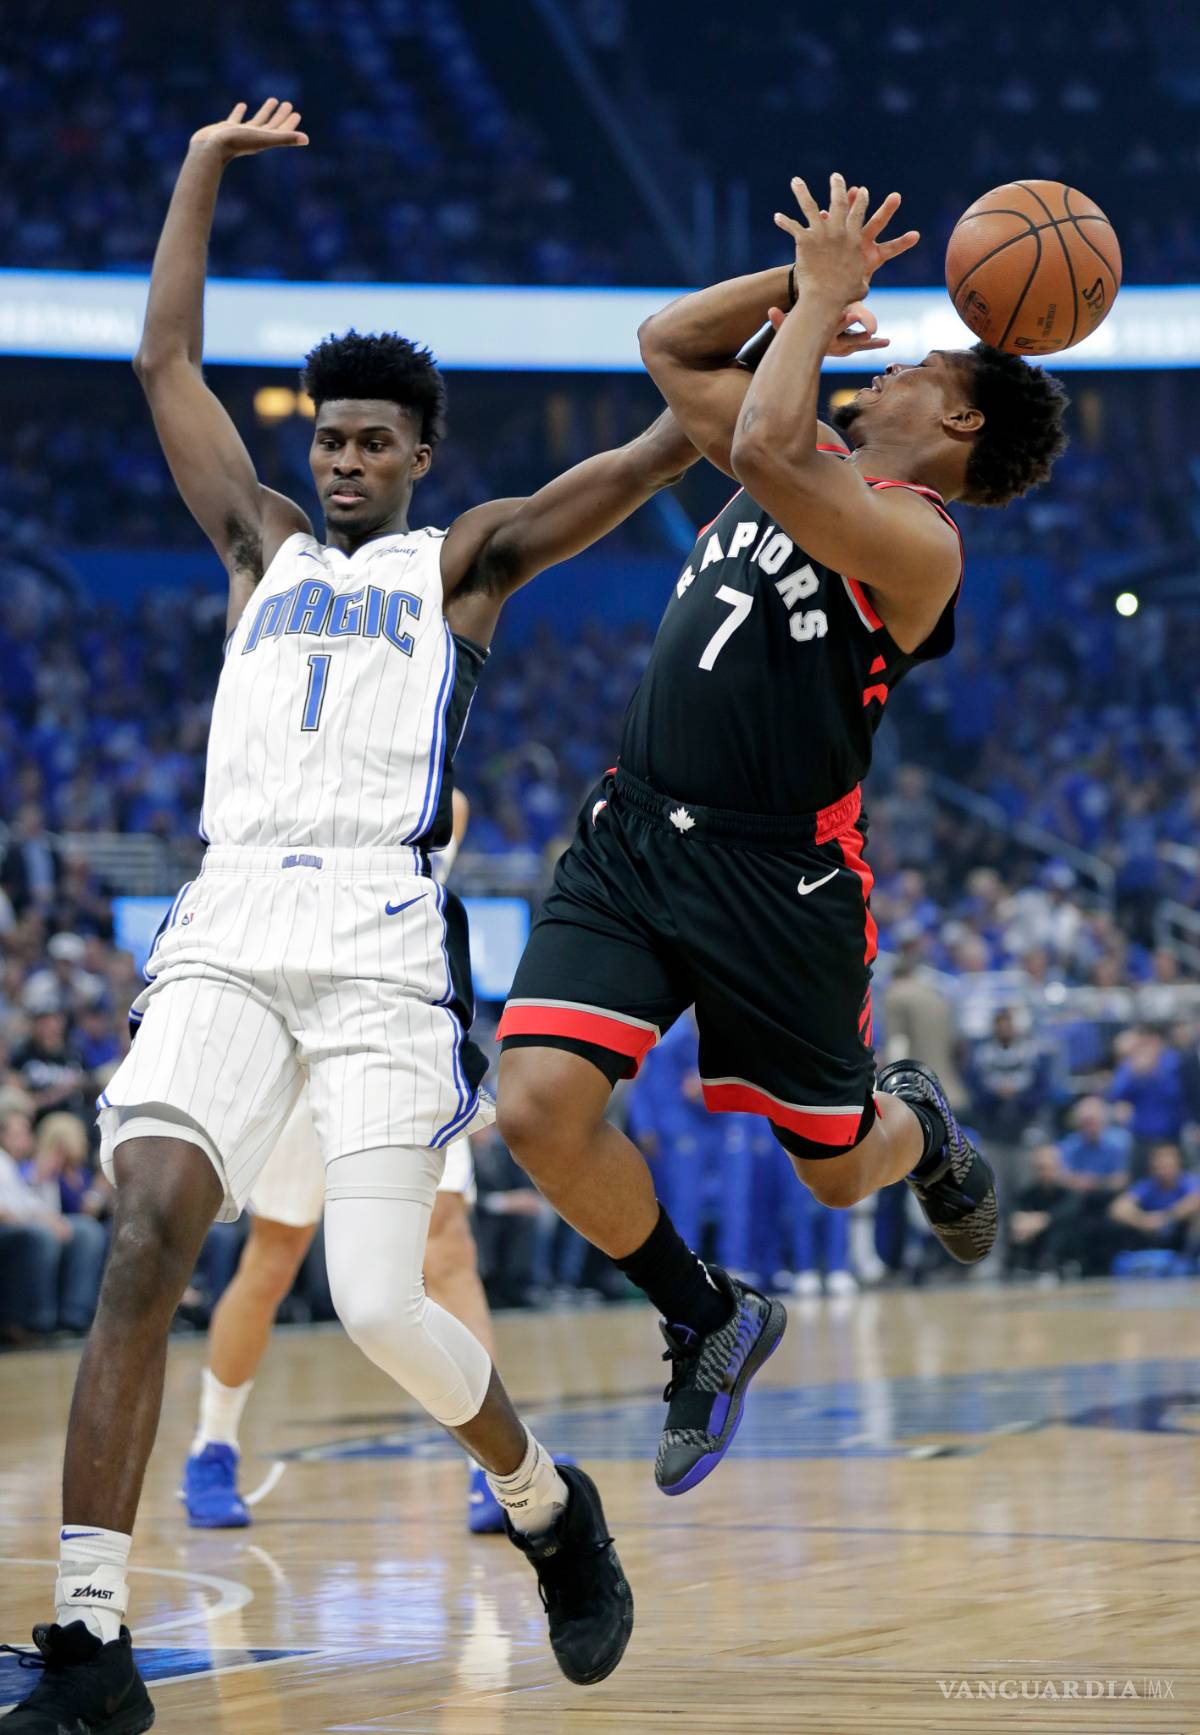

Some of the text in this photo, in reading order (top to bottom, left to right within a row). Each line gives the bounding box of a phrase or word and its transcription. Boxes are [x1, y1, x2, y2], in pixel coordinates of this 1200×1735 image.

[241, 578, 422, 658] MAGIC
[698, 584, 754, 671] 7
[300, 654, 332, 731] 1
[71, 1584, 115, 1600] ZAMST
